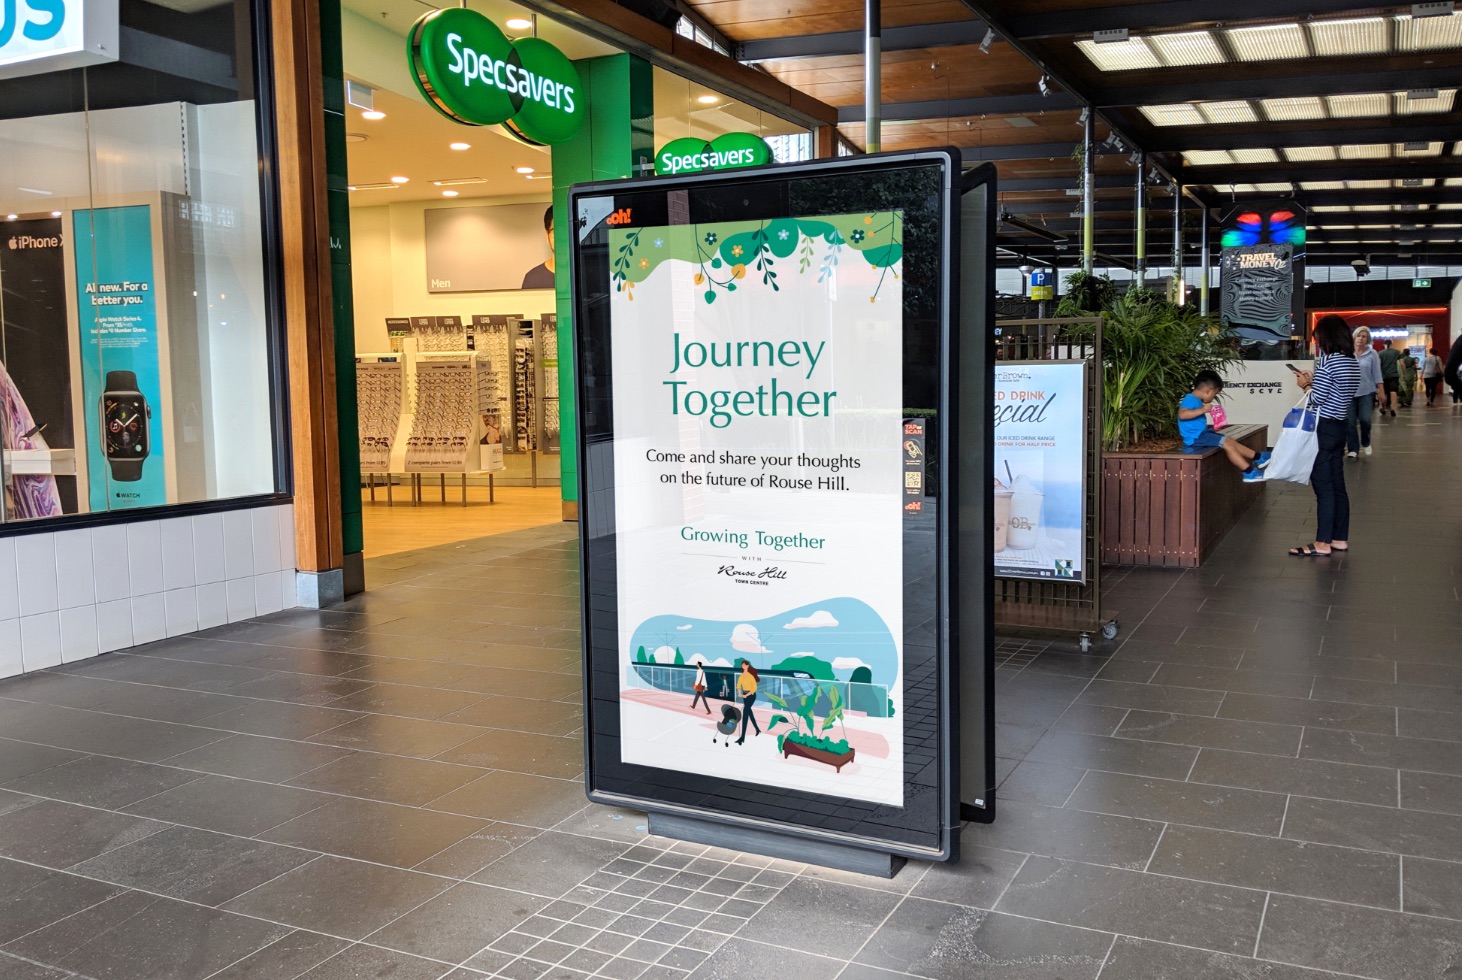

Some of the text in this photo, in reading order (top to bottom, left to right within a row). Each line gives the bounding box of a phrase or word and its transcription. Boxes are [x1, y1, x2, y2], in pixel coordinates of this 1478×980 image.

[446, 32, 575, 114] Specsavers
[661, 148, 754, 175] Specsavers
[19, 236, 58, 249] iPhone
[1240, 252, 1277, 262] TRAVEL
[1240, 260, 1275, 269] MONEY
[431, 279, 451, 288] Men
[1037, 273, 1045, 285] P
[85, 281, 148, 293] Al new. For a
[91, 295, 143, 306] better you.
[670, 333, 825, 379] Journey
[1010, 391, 1045, 400] DRINK
[662, 378, 837, 428] Together
[646, 449, 861, 472] Come and share your thoughts
[660, 471, 850, 491] on the future of Rouse Hill.
[681, 526, 826, 551] Growing Together
[717, 565, 787, 580] Rouse Hill
